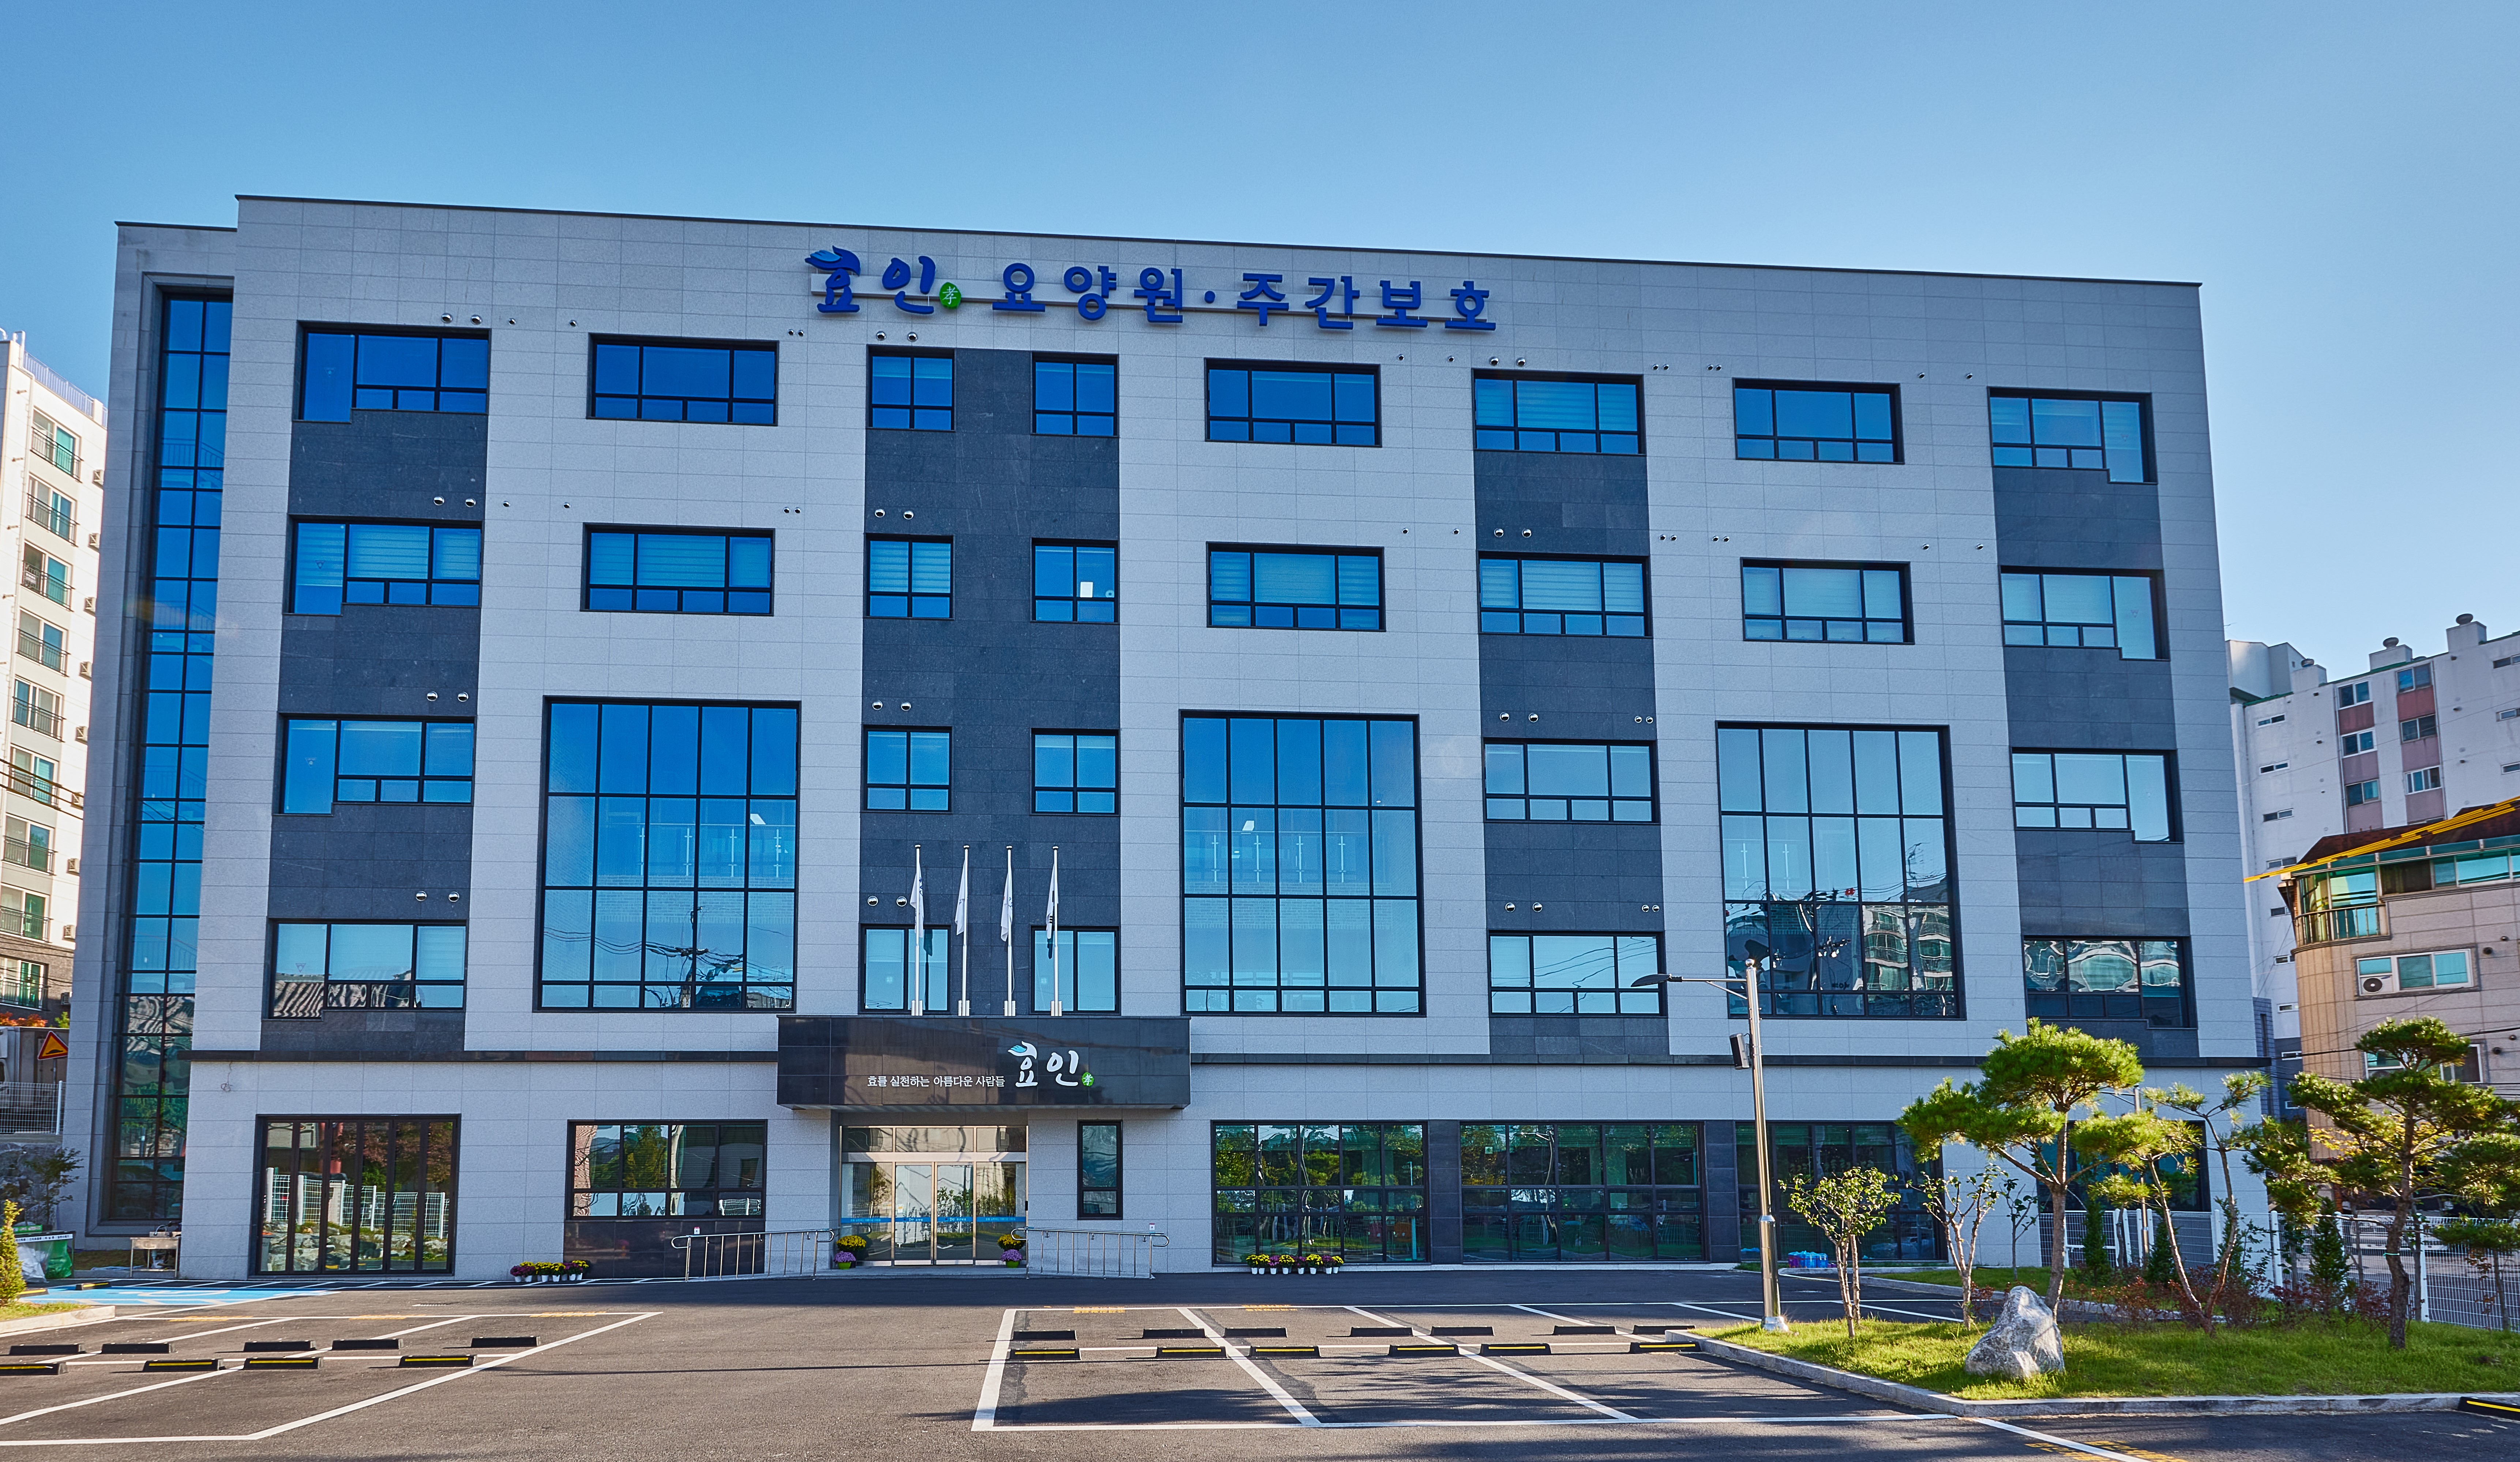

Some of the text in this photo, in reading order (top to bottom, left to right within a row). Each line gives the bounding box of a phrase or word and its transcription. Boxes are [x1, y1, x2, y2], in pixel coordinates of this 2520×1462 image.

[805, 245, 936, 314] 효인
[942, 286, 958, 305] 孝
[992, 263, 1183, 323] 요양원
[1237, 273, 1496, 331] 주간보호
[867, 1076, 1006, 1087] 효를 실천하는 아름다운 사람들
[1008, 1041, 1078, 1087] 효인
